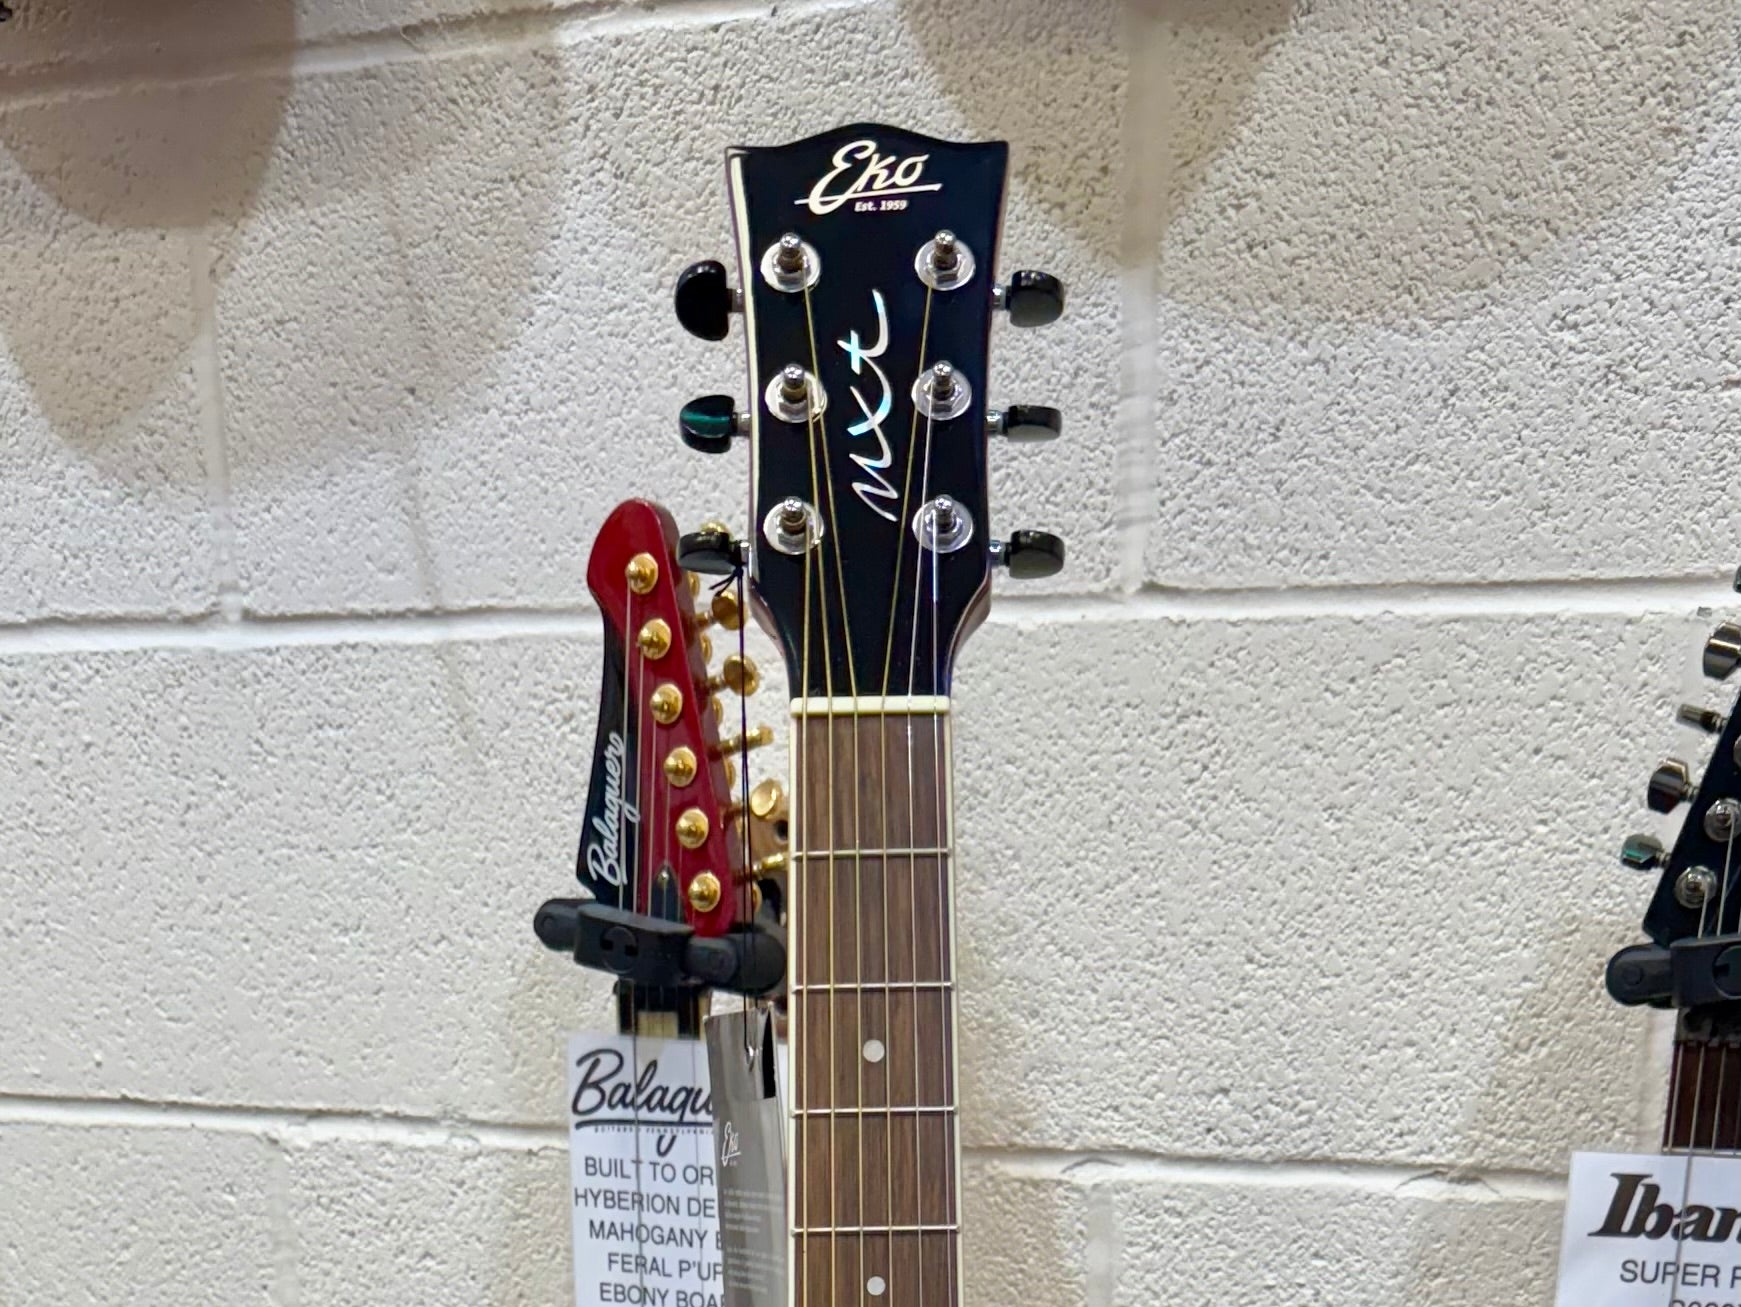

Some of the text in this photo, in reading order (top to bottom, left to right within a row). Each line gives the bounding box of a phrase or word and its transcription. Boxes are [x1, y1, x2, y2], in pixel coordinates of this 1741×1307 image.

[800, 140, 938, 215] Eko
[854, 200, 907, 212] Est. 1959
[584, 1156, 714, 1187] BUILT TO OR
[574, 1188, 680, 1216] HYBERION
[687, 1196, 716, 1219] DE
[589, 1220, 708, 1249] MAHOGANY
[608, 1252, 672, 1278] FERAL
[1619, 1259, 1720, 1289] SUPER
[600, 1282, 669, 1307] EBONY
